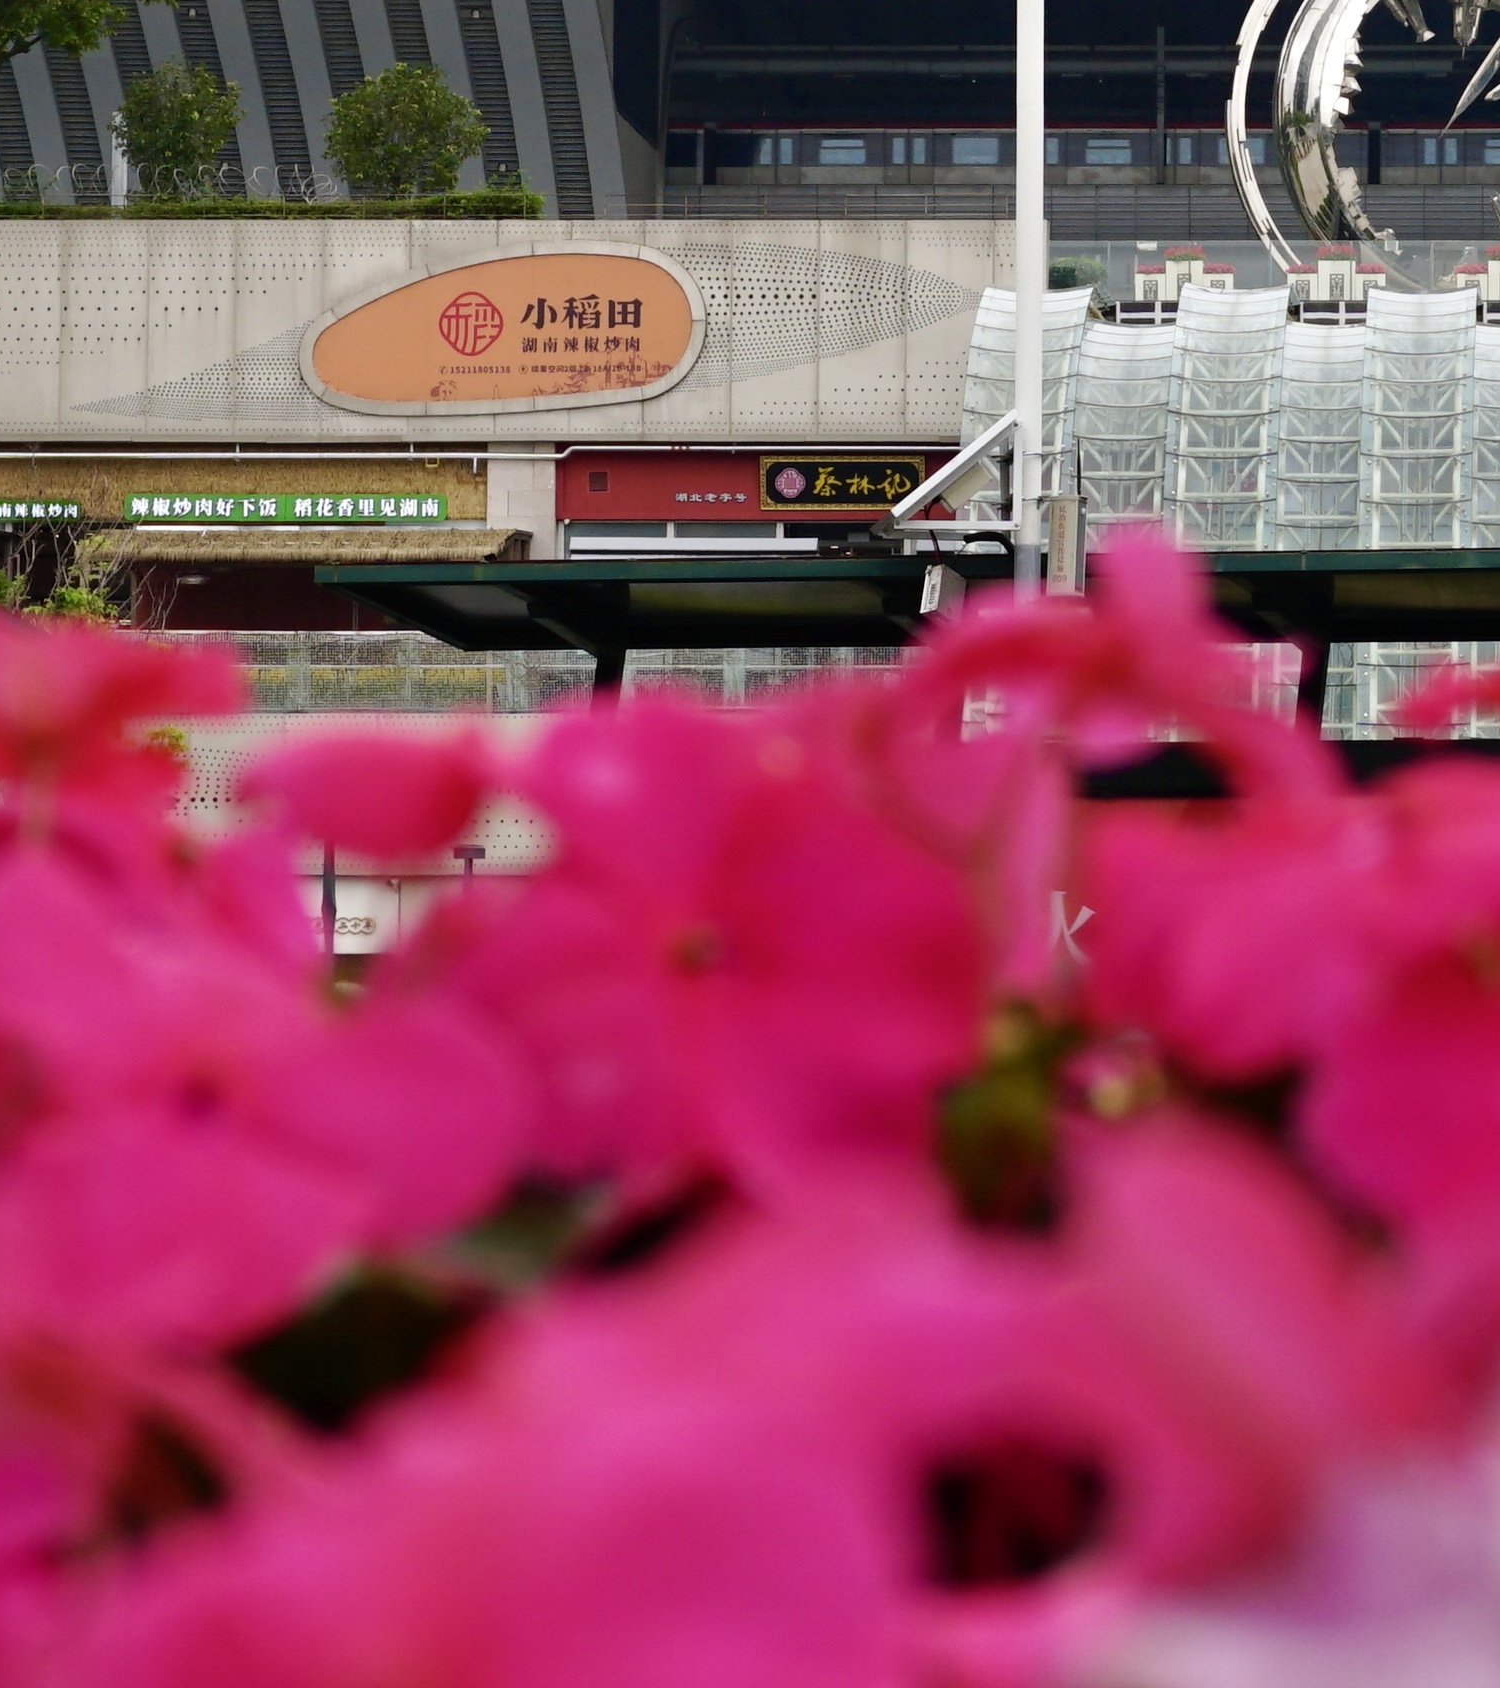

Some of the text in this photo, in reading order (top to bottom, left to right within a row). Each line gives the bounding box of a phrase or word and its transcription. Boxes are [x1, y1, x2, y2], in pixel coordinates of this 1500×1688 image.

[520, 293, 643, 330] 小稻田
[521, 336, 641, 354] 湖南辣椒炒肉
[674, 492, 748, 503] 湖北老字号
[130, 497, 440, 518] 辣椒炒肉好下饭 稻花香里见湖南
